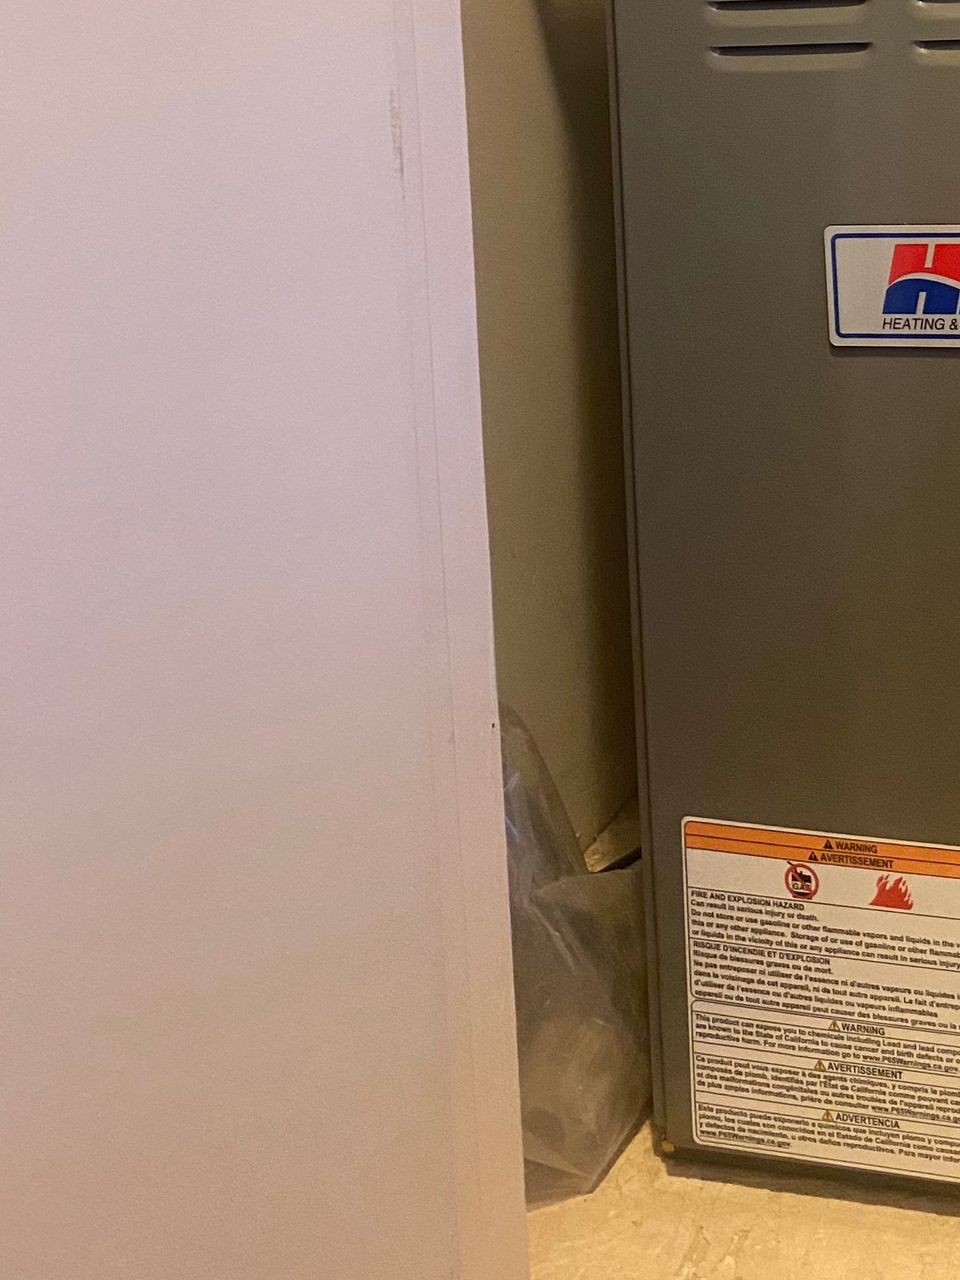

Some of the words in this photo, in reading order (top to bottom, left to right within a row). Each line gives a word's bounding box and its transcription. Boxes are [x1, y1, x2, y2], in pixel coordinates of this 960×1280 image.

[882, 318, 946, 332] HEATING
[950, 319, 958, 332] &
[835, 842, 877, 854] WARNING
[820, 853, 893, 869] AVERTISSEMENT
[690, 890, 708, 898] FIRE
[708, 892, 726, 901] AND
[726, 894, 771, 906] EXPLOSION
[771, 900, 804, 910] HAZARD
[705, 901, 727, 910] result
[735, 905, 763, 914] serious
[763, 908, 785, 918] injury
[795, 912, 819, 921] death.
[714, 912, 734, 920] store
[758, 917, 791, 928] gasoline
[800, 922, 821, 931] other
[821, 925, 861, 936] flammable
[861, 931, 888, 940] vapors
[904, 935, 931, 946] liquids
[694, 1014, 711, 1022] This
[710, 1016, 740, 1027] product
[754, 1023, 782, 1033] expose
[782, 1027, 797, 1035] you
[806, 1029, 845, 1040] chemicals
[845, 1034, 881, 1046] including
[901, 1042, 917, 1050] and
[917, 1044, 935, 1052] lead
[841, 1022, 885, 1035] WARNING
[827, 1061, 902, 1079] AVERTISSEMENT
[835, 1112, 899, 1128] ADVERTENCIA
